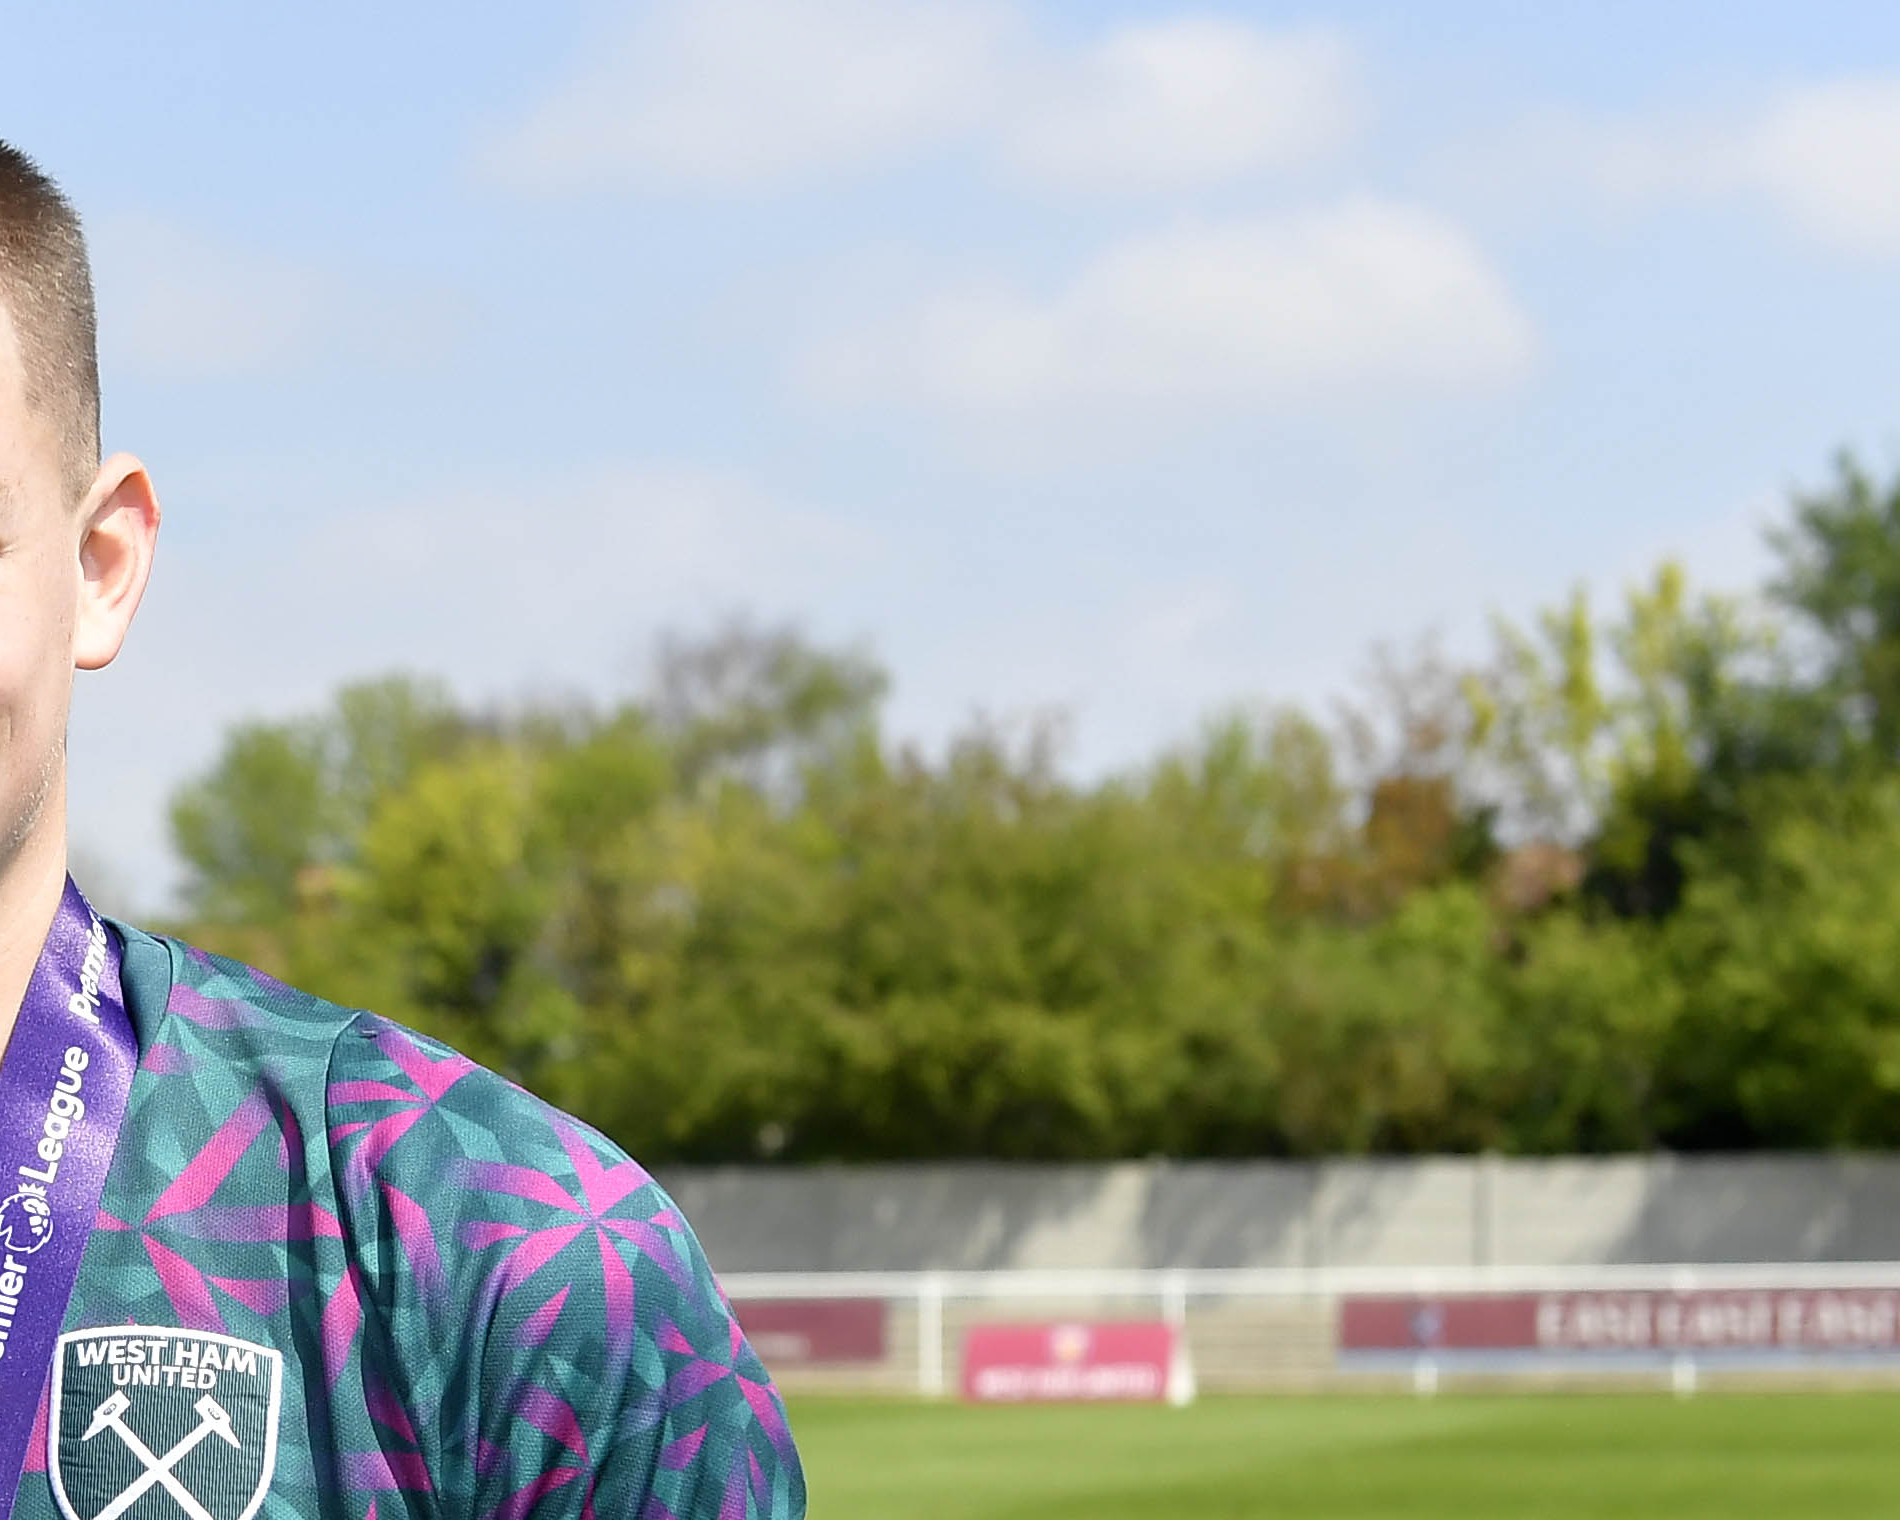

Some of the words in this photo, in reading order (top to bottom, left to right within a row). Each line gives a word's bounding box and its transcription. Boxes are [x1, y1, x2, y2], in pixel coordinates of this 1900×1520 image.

[68, 912, 107, 1024] Premie
[19, 1046, 90, 1184] League
[77, 1340, 168, 1367] WEST
[175, 1343, 257, 1376] HAM
[113, 1365, 217, 1389] UNITED
